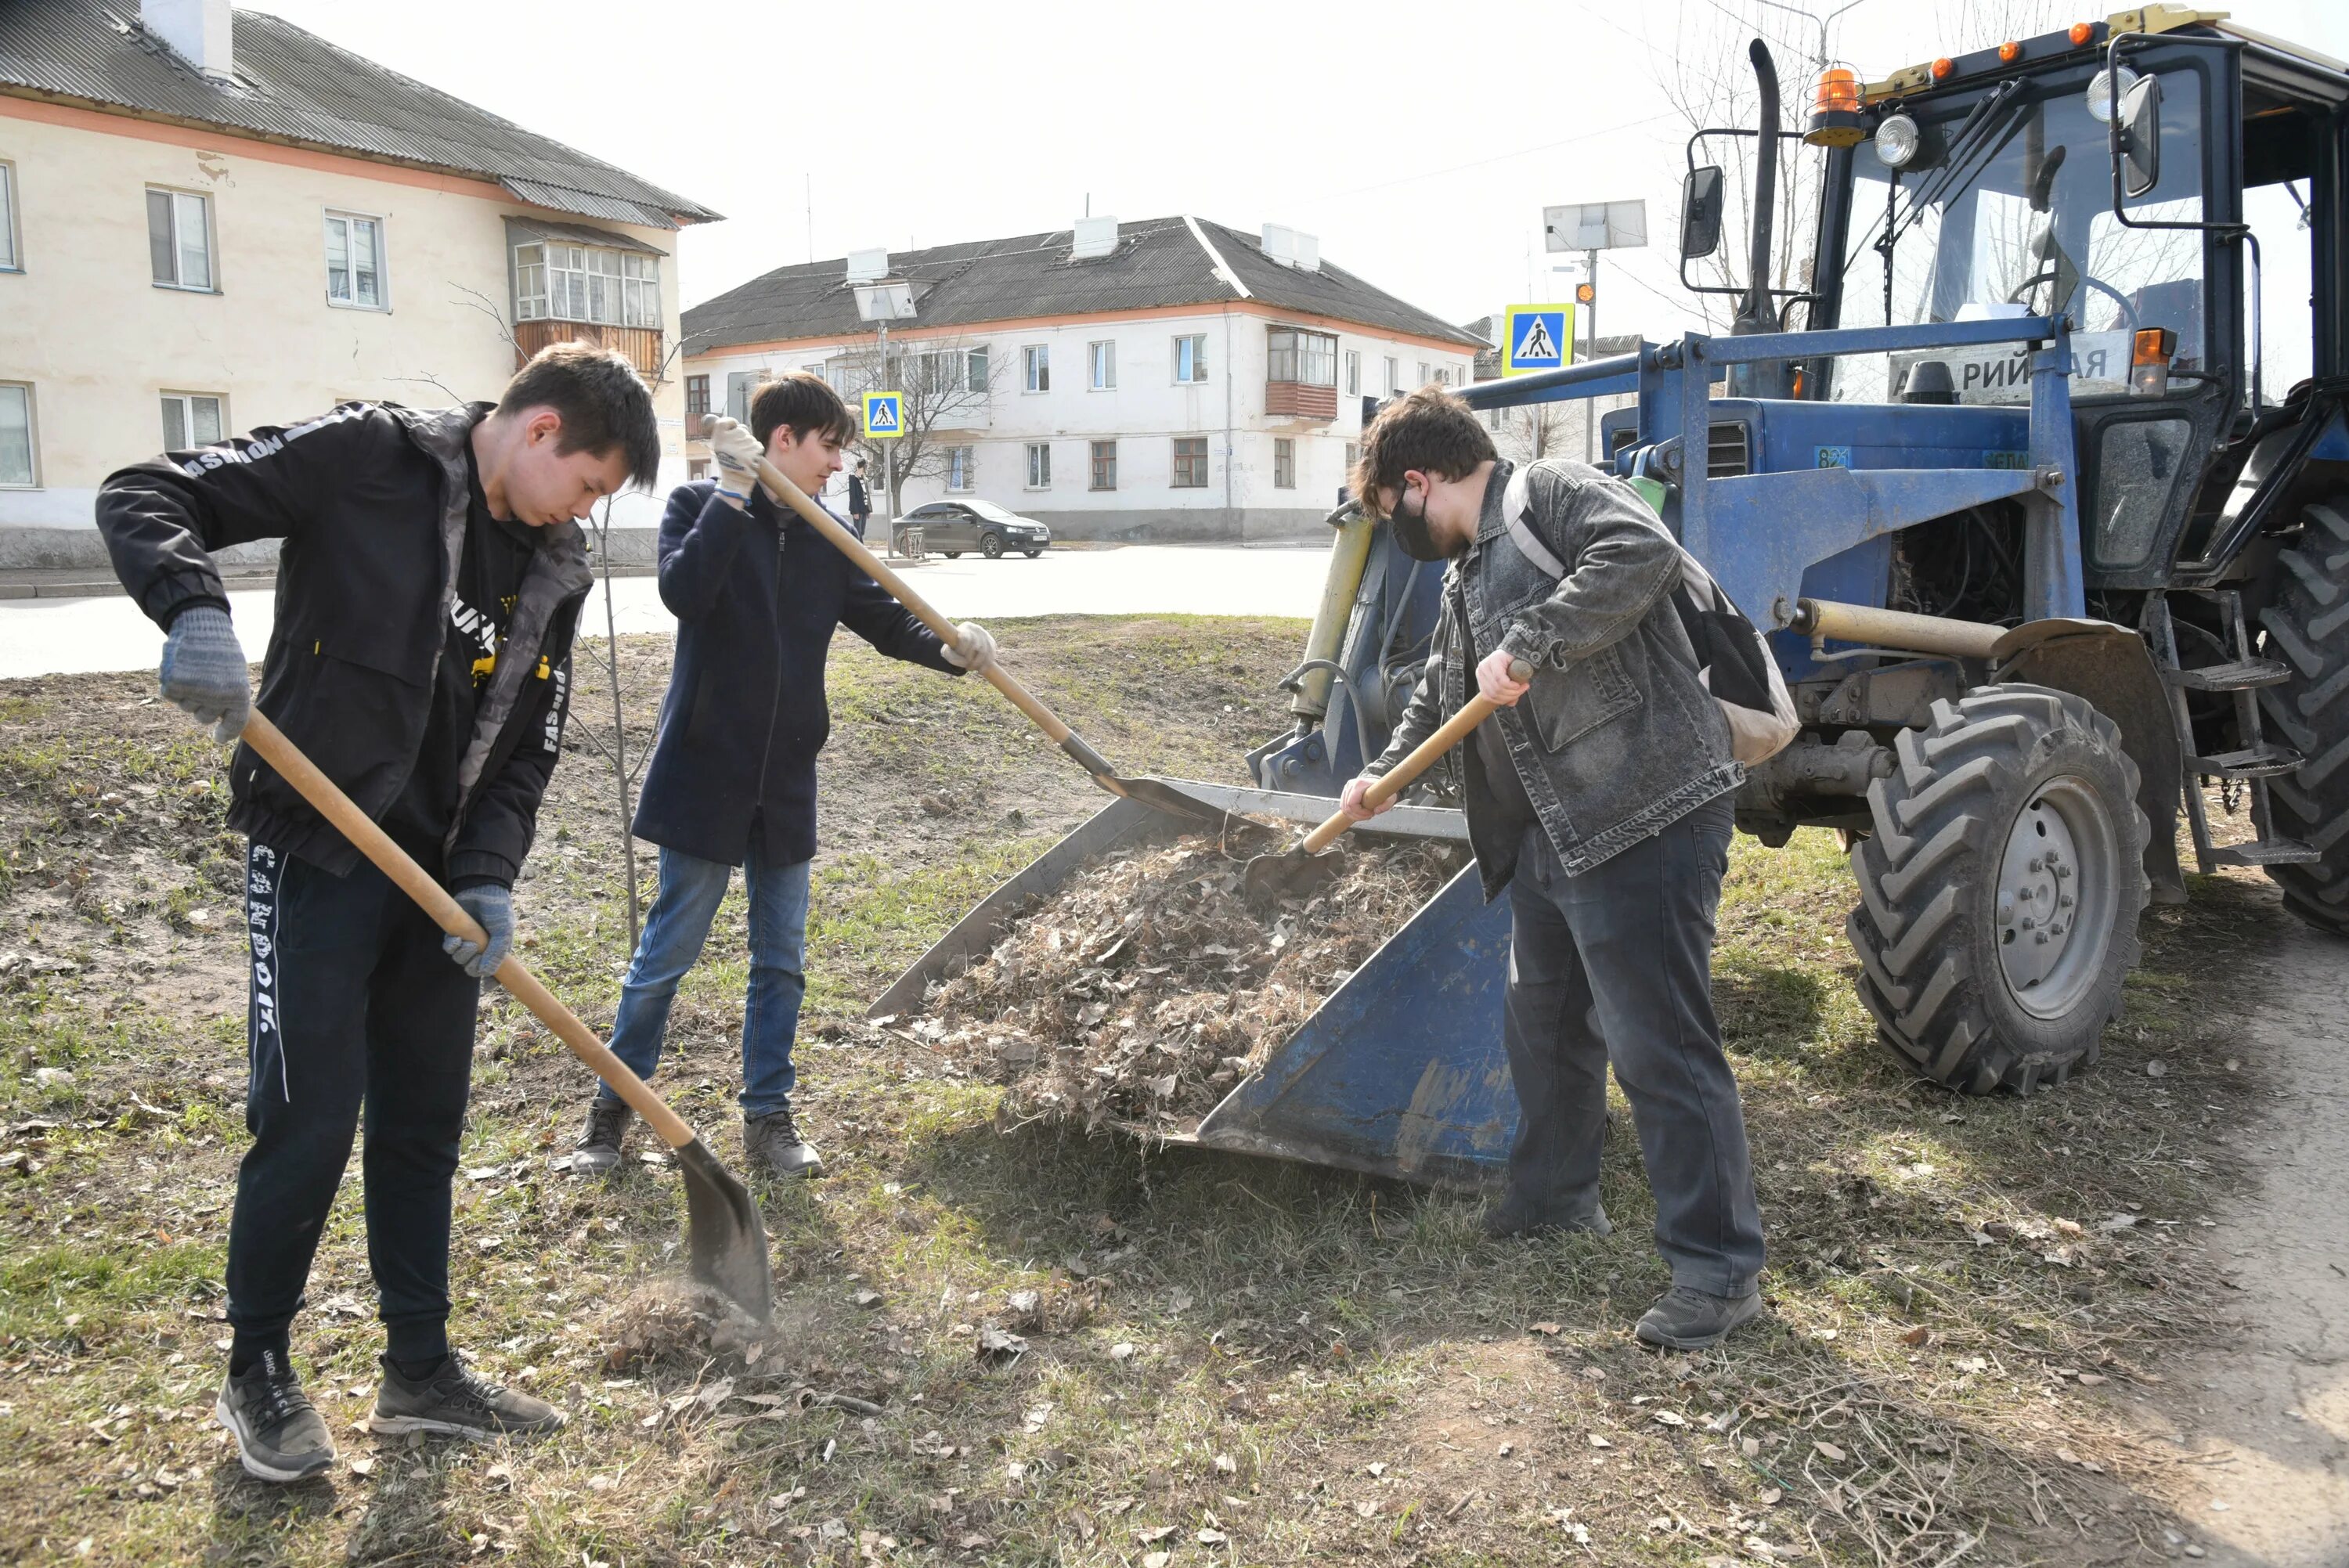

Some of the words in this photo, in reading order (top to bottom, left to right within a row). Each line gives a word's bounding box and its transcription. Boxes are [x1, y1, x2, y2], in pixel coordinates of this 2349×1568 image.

[1893, 349, 2106, 396] АРИЙАЯ
[171, 434, 284, 478] ASHION
[543, 659, 566, 753] FASHIO
